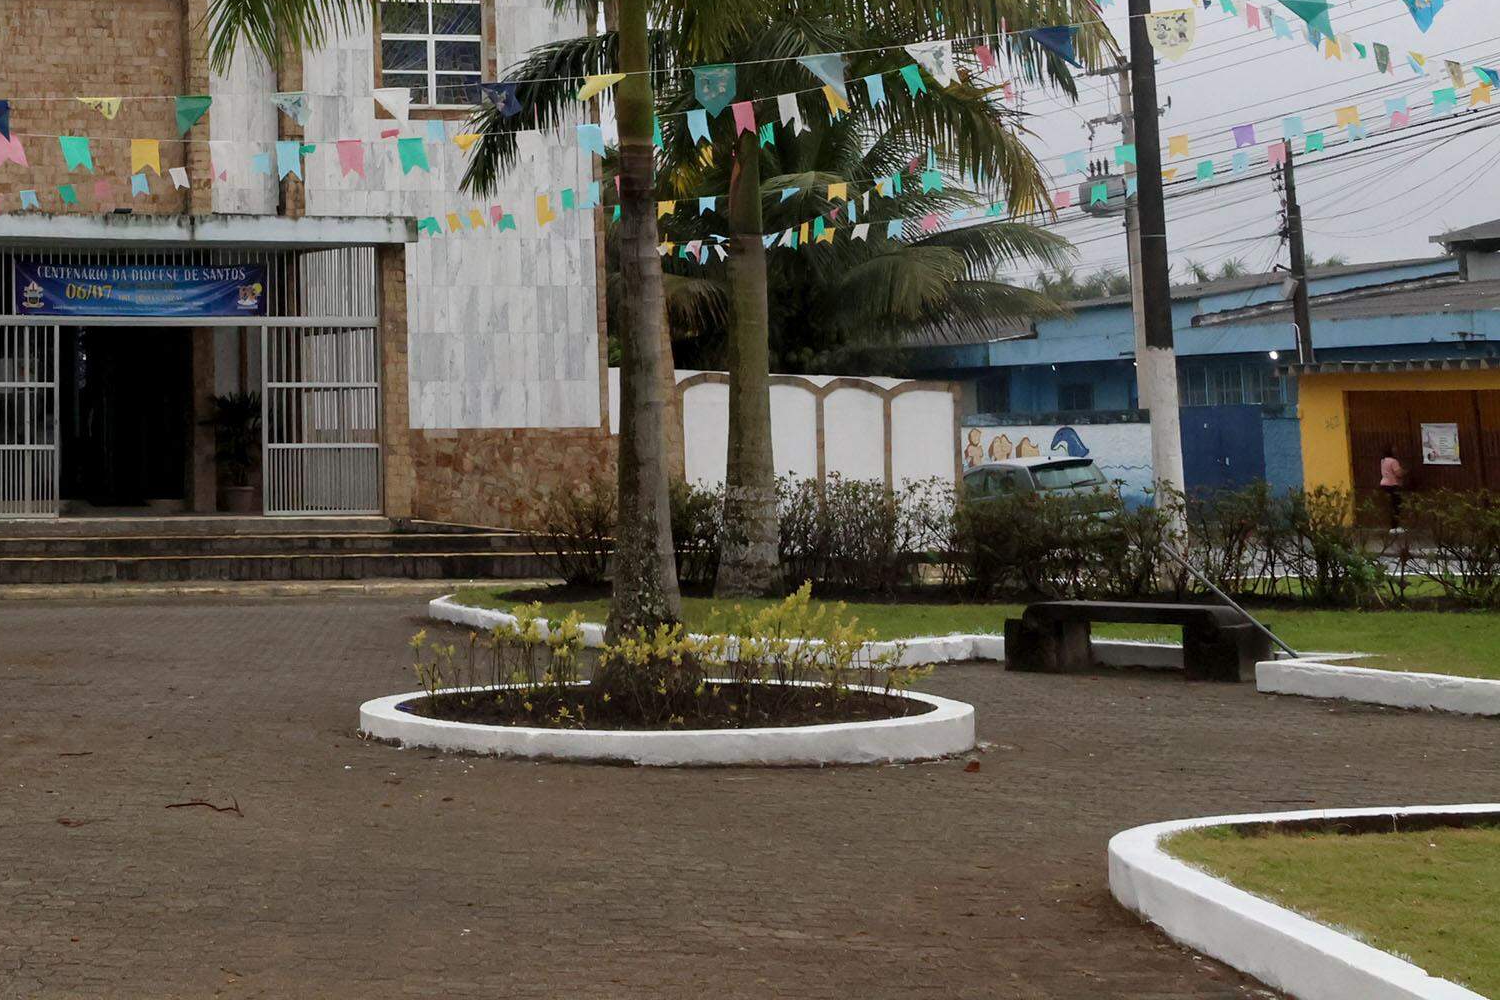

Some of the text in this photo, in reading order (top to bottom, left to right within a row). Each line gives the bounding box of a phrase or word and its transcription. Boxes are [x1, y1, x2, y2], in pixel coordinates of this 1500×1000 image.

[113, 267, 127, 281] DA
[131, 268, 180, 281] DIOCESE
[184, 268, 200, 281] DE
[203, 266, 246, 281] SANTOS
[65, 283, 113, 300] 06/07
